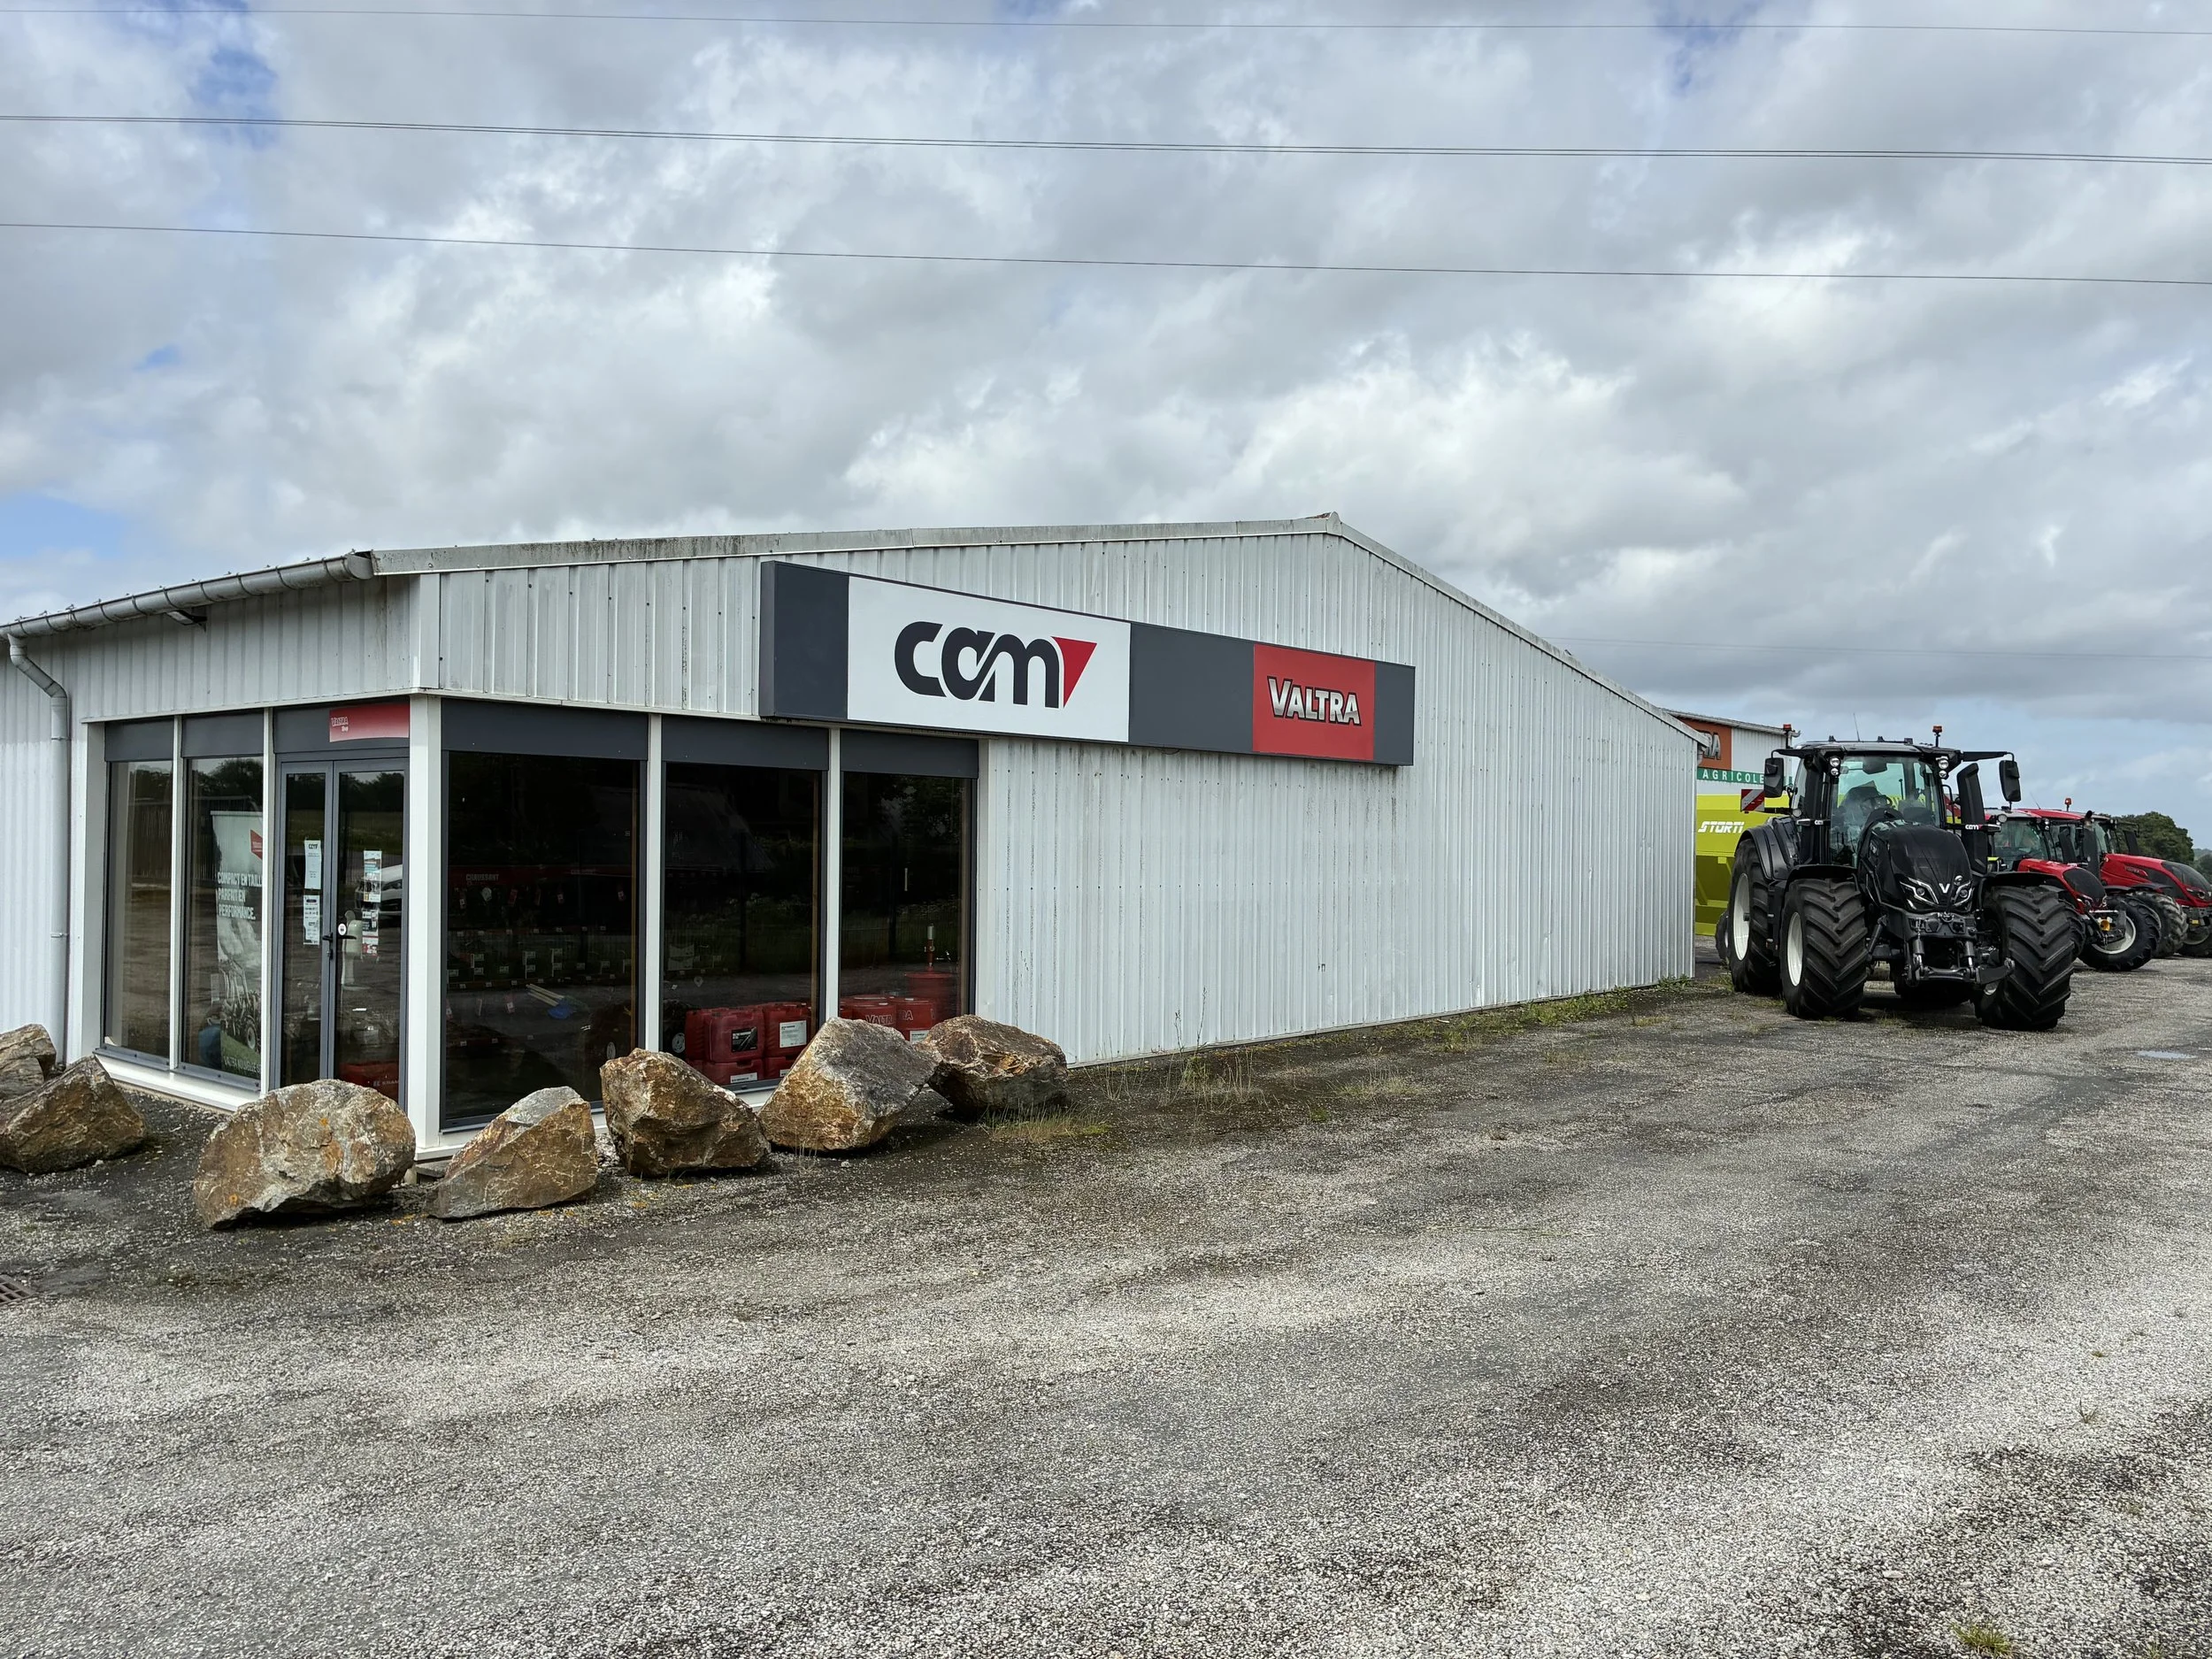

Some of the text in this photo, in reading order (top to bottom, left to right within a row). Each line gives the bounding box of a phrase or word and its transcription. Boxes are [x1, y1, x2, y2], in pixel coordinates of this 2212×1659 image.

[1267, 675, 1363, 726] VALTRA
[1702, 769, 1765, 784] AGRICOLE
[1697, 821, 1745, 833] STORTI
[217, 872, 263, 887] COMPACT EN TAILL
[218, 887, 238, 901] PARFAIT
